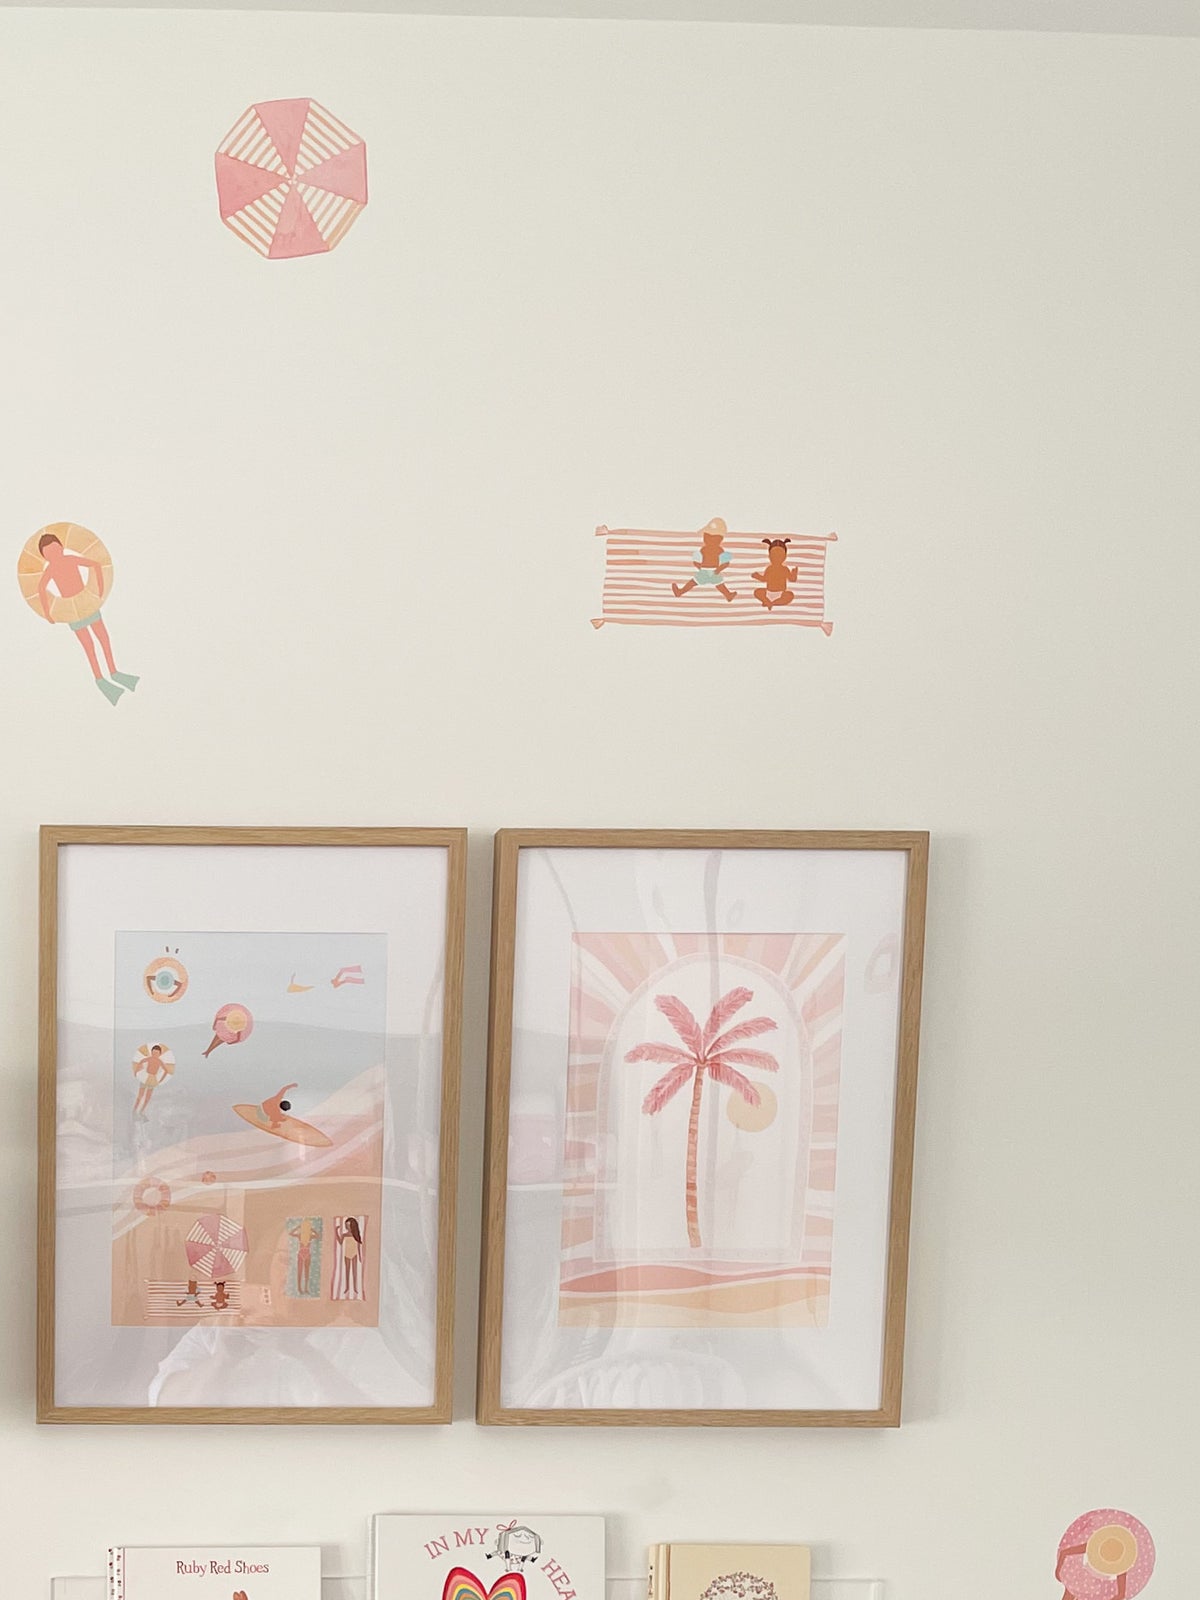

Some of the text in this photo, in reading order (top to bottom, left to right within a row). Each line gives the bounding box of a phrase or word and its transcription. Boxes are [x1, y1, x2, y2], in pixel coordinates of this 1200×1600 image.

[424, 1535, 450, 1559] IN
[453, 1527, 489, 1548] MY
[176, 1559, 269, 1577] Ruby Red Shoes
